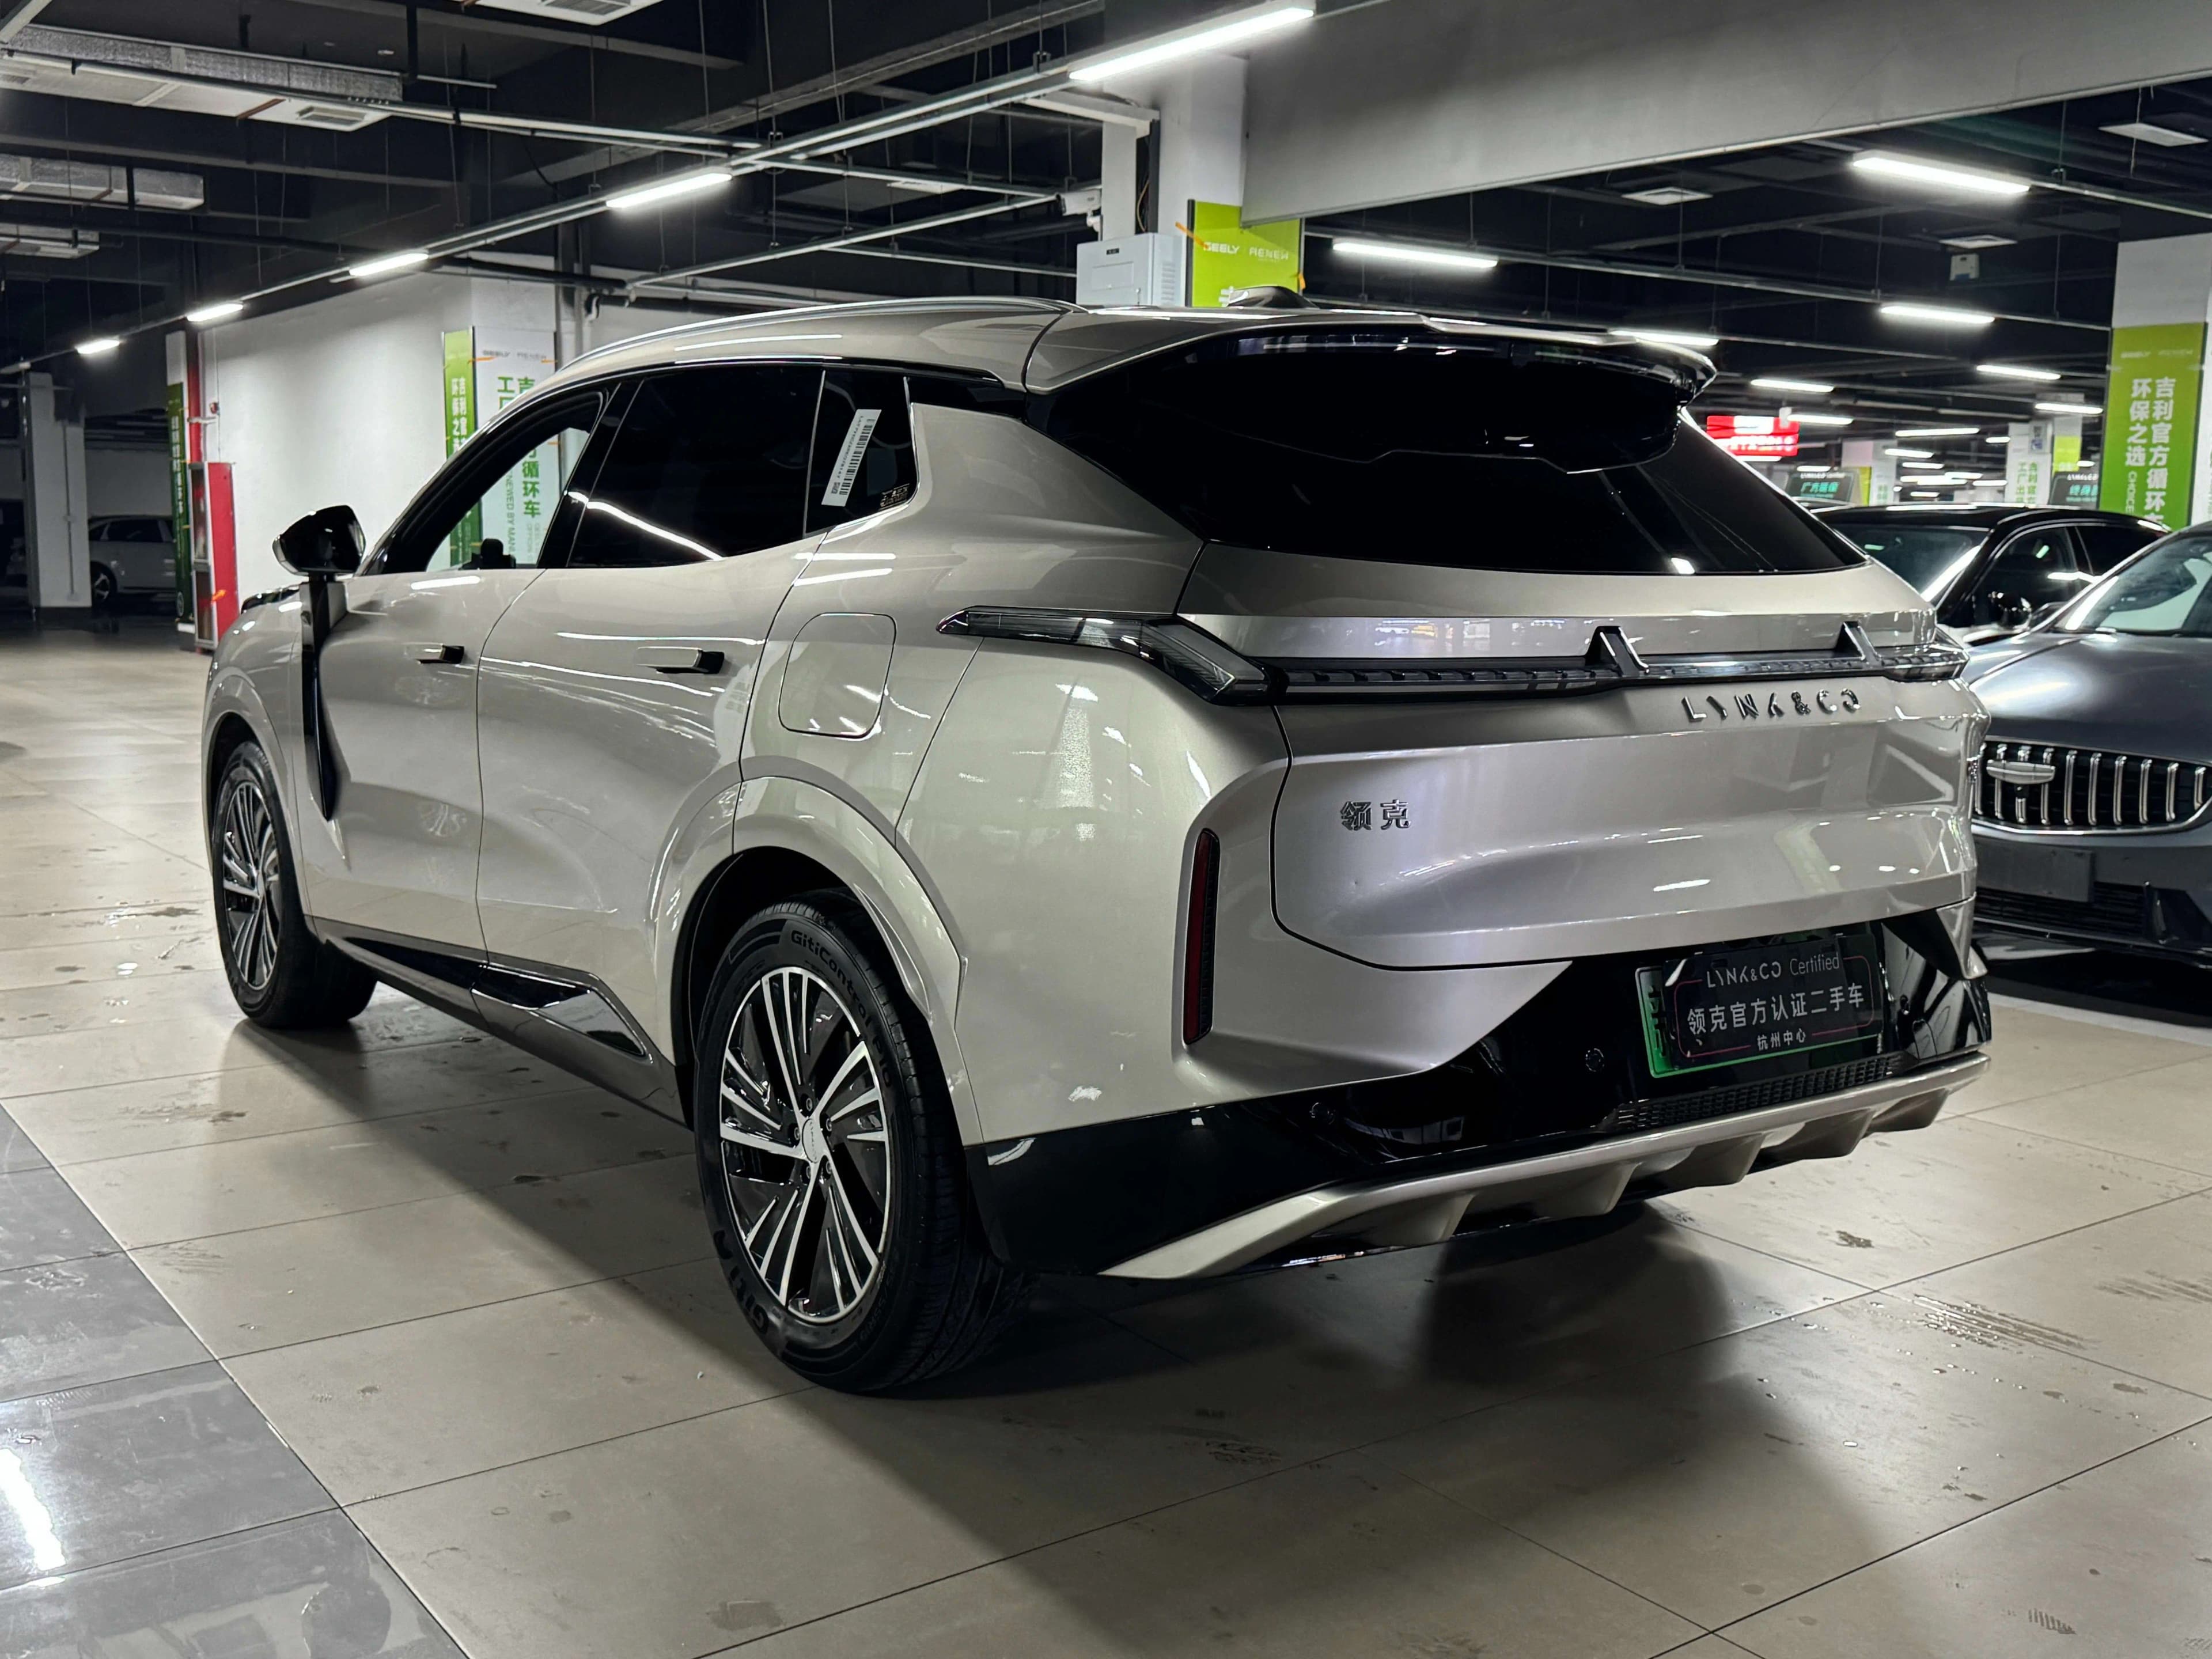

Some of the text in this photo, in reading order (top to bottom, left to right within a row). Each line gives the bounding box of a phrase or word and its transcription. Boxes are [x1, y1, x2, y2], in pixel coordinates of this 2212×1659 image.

[2125, 377, 2152, 467] 环保之选
[1340, 799, 1411, 831] 领克
[1707, 952, 1840, 988] LYNK&CO Certified
[1687, 982, 1865, 1036] 领克官方认证二手车
[1757, 1028, 1807, 1051] 杭州中心
